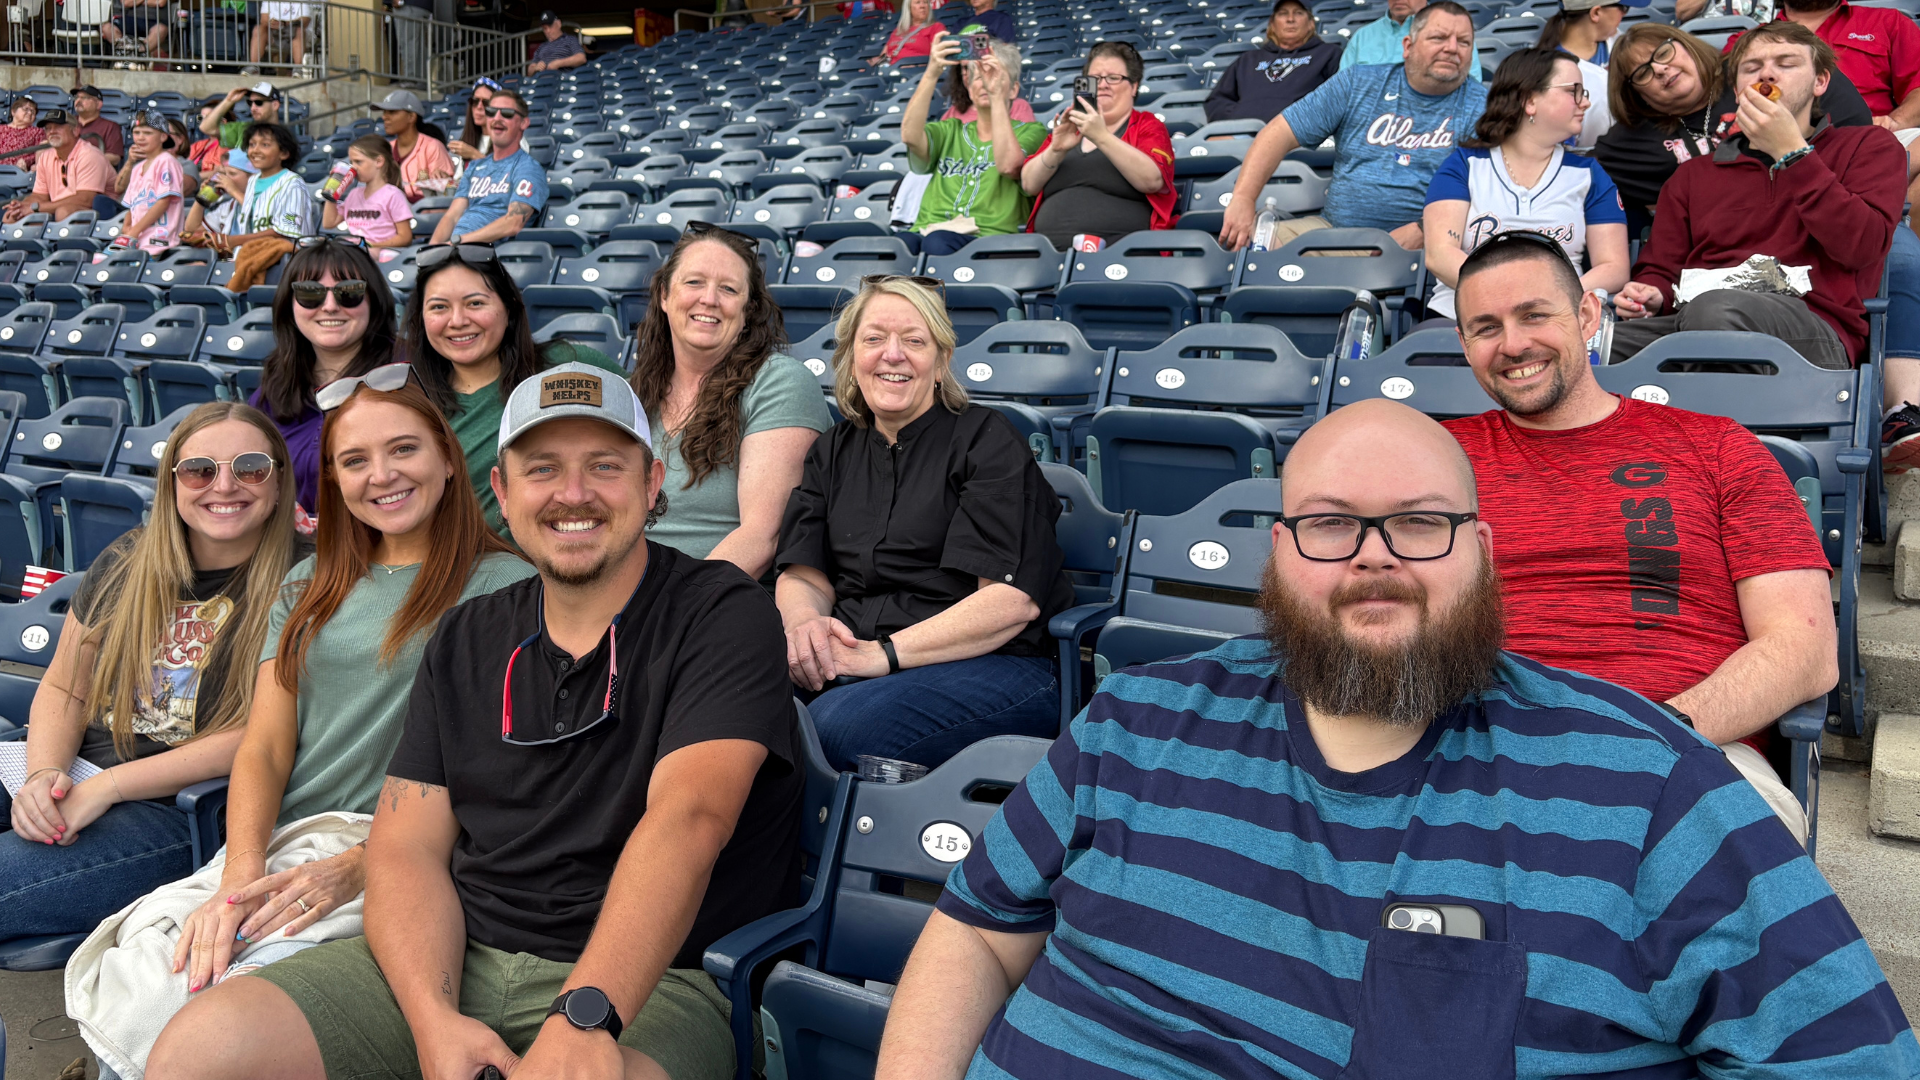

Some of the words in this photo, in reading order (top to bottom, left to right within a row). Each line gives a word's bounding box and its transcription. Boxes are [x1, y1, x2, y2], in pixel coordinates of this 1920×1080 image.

[1367, 113, 1454, 149] Atlanta
[1360, 330, 1372, 360] mart
[973, 368, 986, 376] 15
[1163, 374, 1178, 383] 16
[544, 379, 599, 391] WHISKEY
[1389, 383, 1406, 393] 17
[552, 390, 591, 402] HELPS
[1642, 391, 1660, 402] 18
[1609, 462, 1669, 489] G
[1200, 550, 1219, 562] 16
[28, 632, 42, 645] 11
[934, 834, 959, 852] 15
